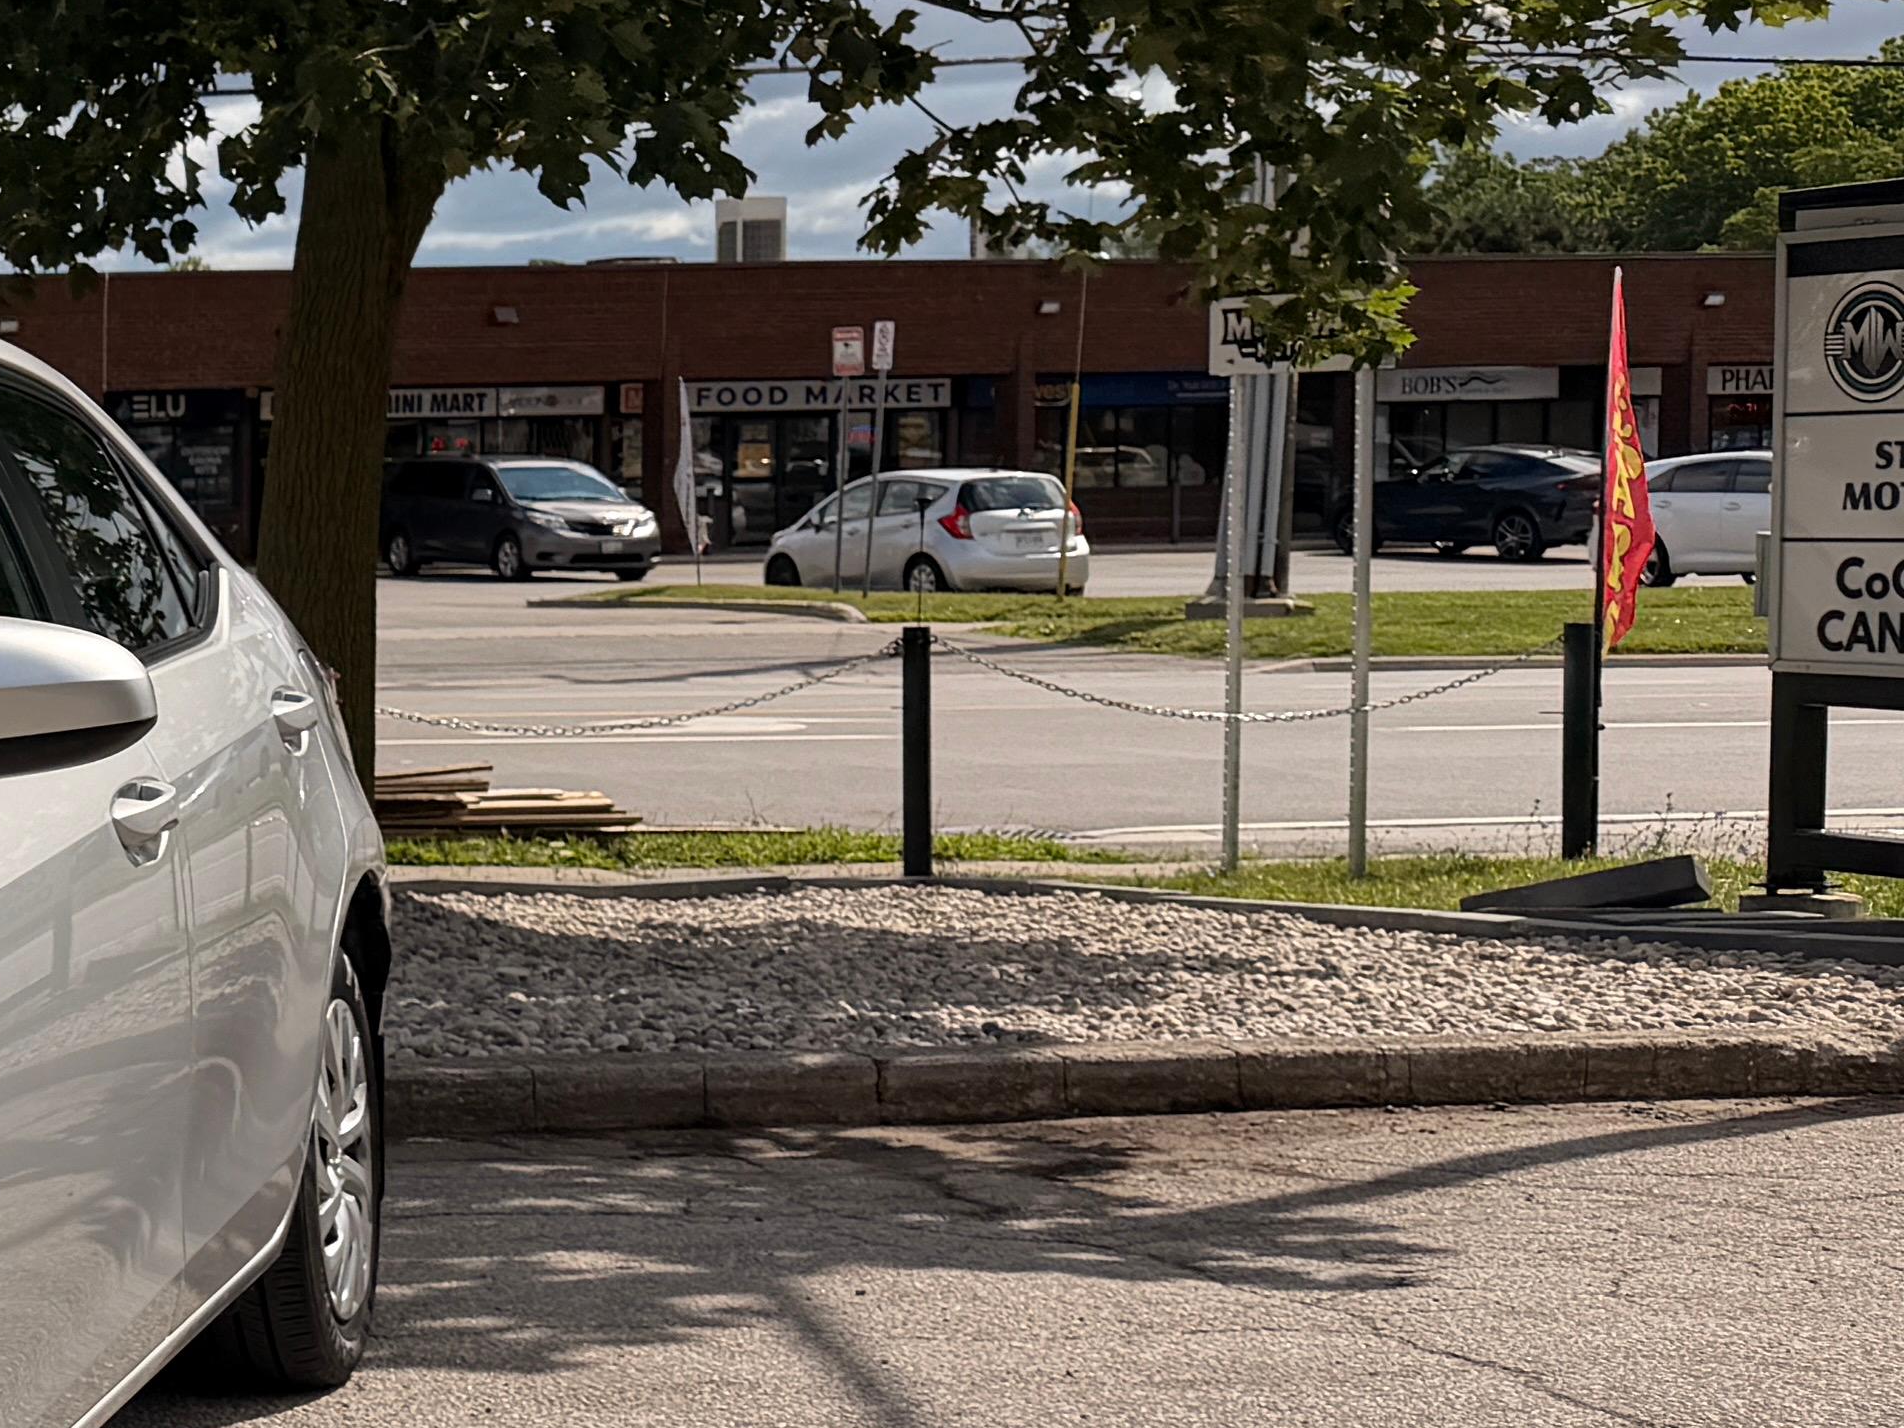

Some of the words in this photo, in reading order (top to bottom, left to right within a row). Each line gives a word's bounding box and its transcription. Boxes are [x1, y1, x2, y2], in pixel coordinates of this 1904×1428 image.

[696, 386, 789, 407] FOOD
[805, 382, 946, 405] MARKET
[1400, 376, 1457, 395] BOB'S
[430, 392, 488, 413] MART
[1842, 481, 1904, 511] MO
[1817, 609, 1904, 654] CAN
